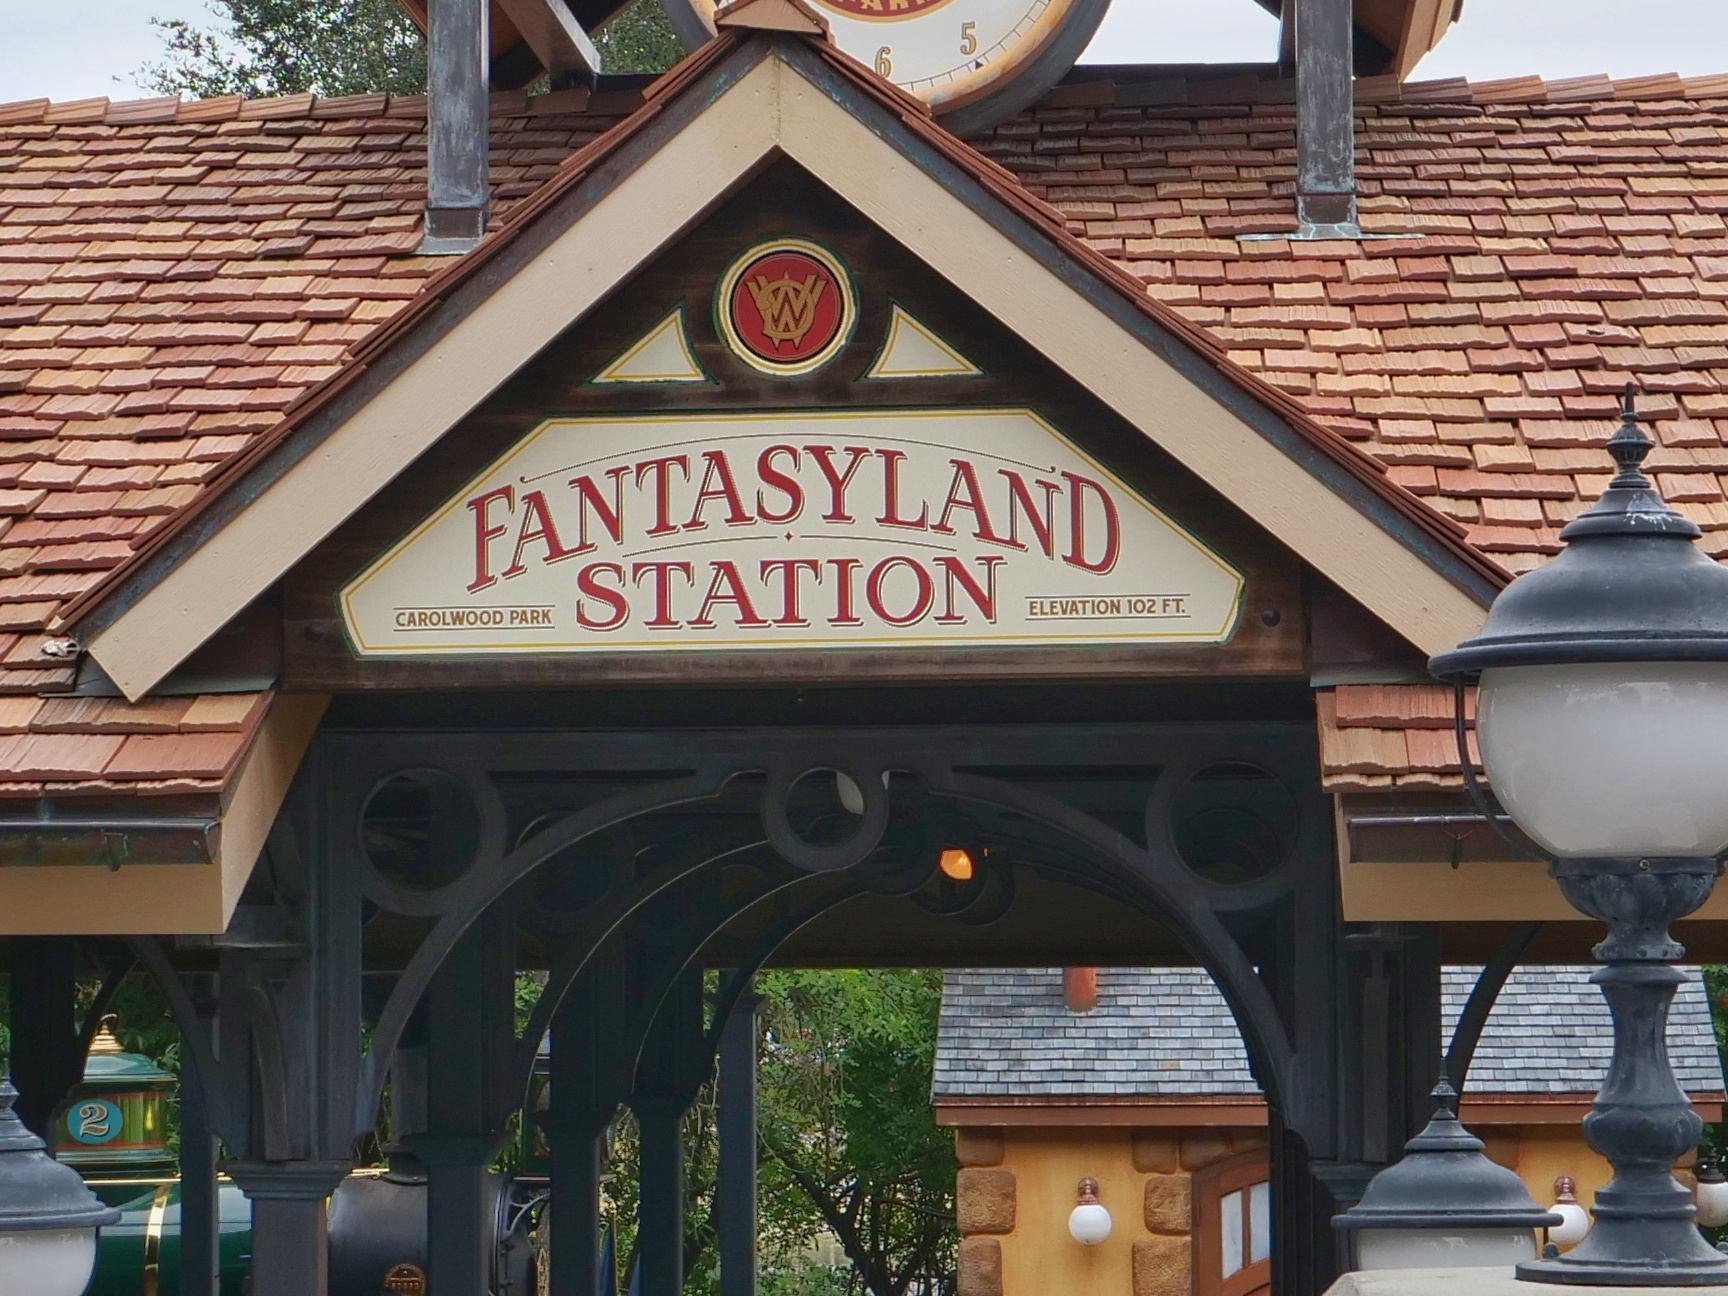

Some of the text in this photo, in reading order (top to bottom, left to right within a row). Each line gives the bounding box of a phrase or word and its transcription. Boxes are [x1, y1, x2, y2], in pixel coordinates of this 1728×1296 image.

[961, 22, 977, 54] 5
[875, 46, 892, 78] 6
[467, 444, 1122, 594] FANTASYLAND
[575, 555, 1008, 632] STATION
[1029, 598, 1186, 616] ELEVATION 102 FT.
[395, 609, 552, 627] CAROLWOOD PARK
[80, 1103, 109, 1137] 2
